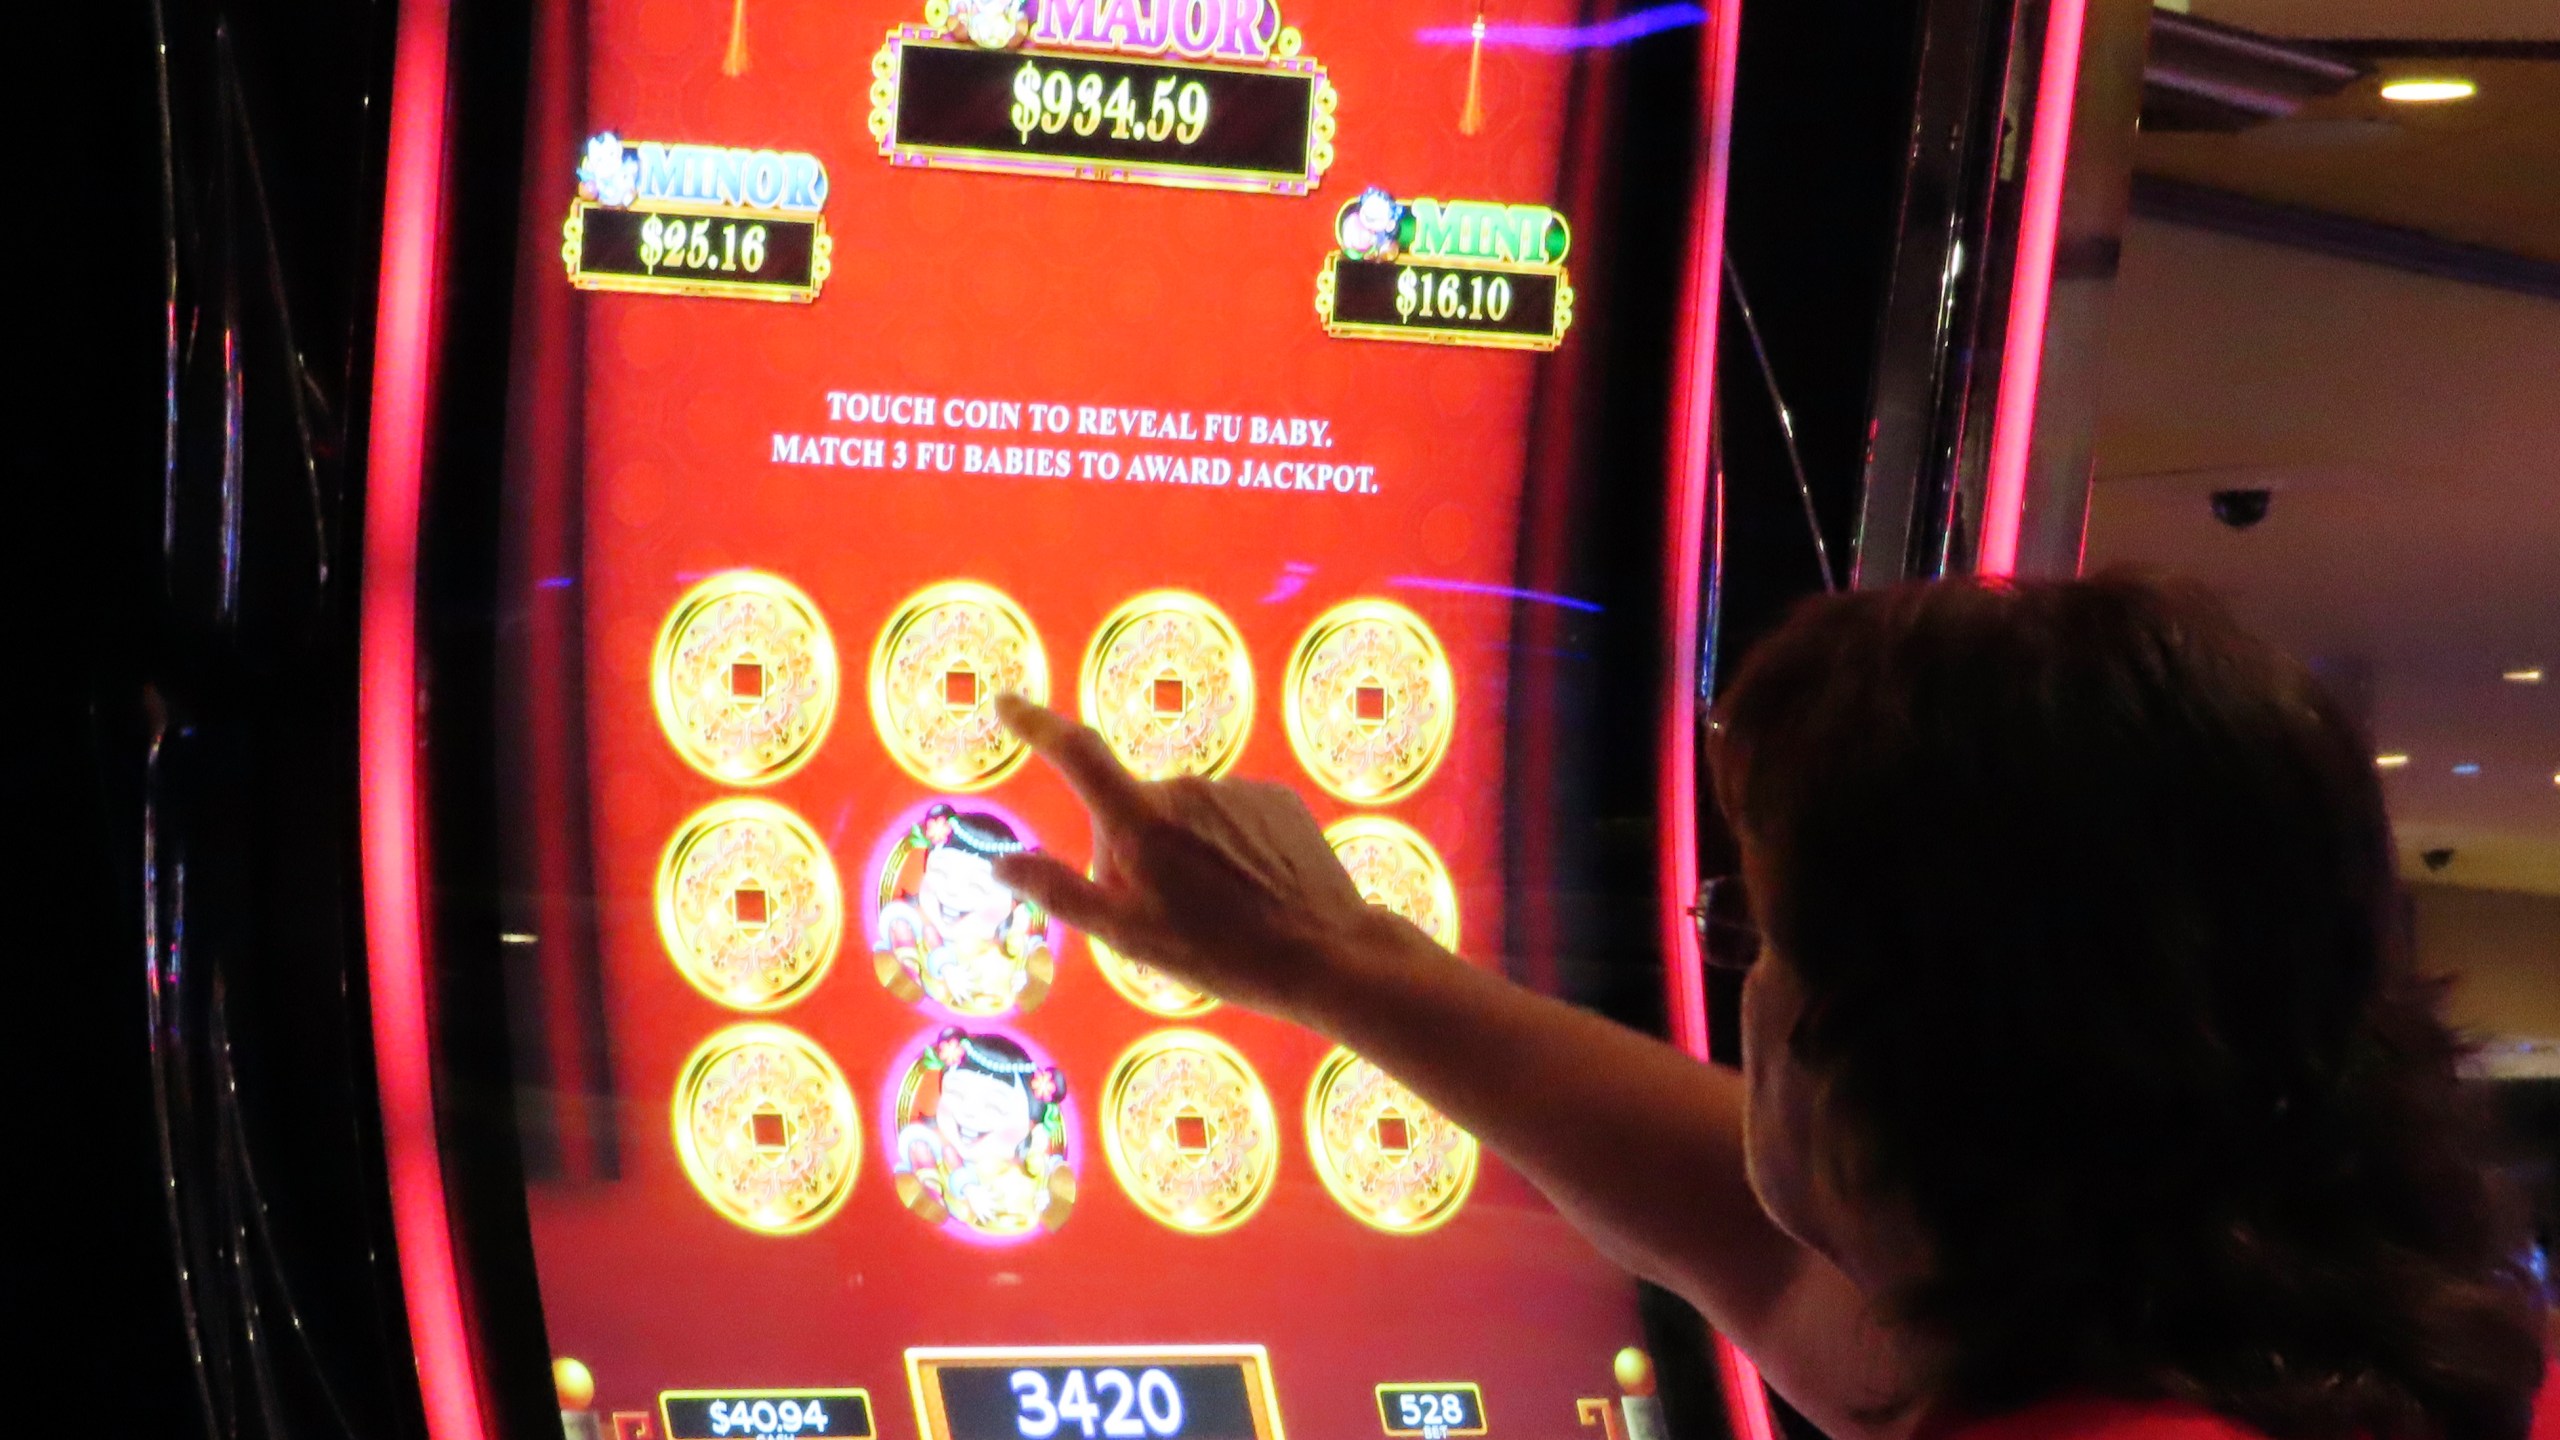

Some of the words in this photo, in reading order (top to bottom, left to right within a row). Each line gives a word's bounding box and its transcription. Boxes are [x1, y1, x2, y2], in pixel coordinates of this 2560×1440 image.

[1035, 0, 1268, 59] MAJOR
[1011, 60, 1211, 145] $934.59
[638, 143, 823, 210] MINOR
[639, 212, 767, 275] $25.16
[1412, 198, 1553, 264] MINI
[1395, 265, 1512, 325] $16.10
[827, 391, 937, 427] TOUCH
[942, 398, 1022, 431] COIN
[1028, 403, 1071, 434] TO
[1077, 405, 1198, 442] REVEAL
[1203, 413, 1243, 444] FU
[1249, 415, 1334, 449] BABY.
[772, 433, 886, 469] MATCH
[892, 440, 908, 470] 3
[915, 441, 956, 473] FU
[962, 443, 1072, 479] BABIES
[1078, 450, 1121, 481] TO
[1124, 454, 1232, 487] AWARD
[1238, 459, 1380, 495] JACKPOT.
[709, 1399, 828, 1436] $40.94
[1010, 1368, 1183, 1438] 3420
[1400, 1393, 1464, 1426] 528
